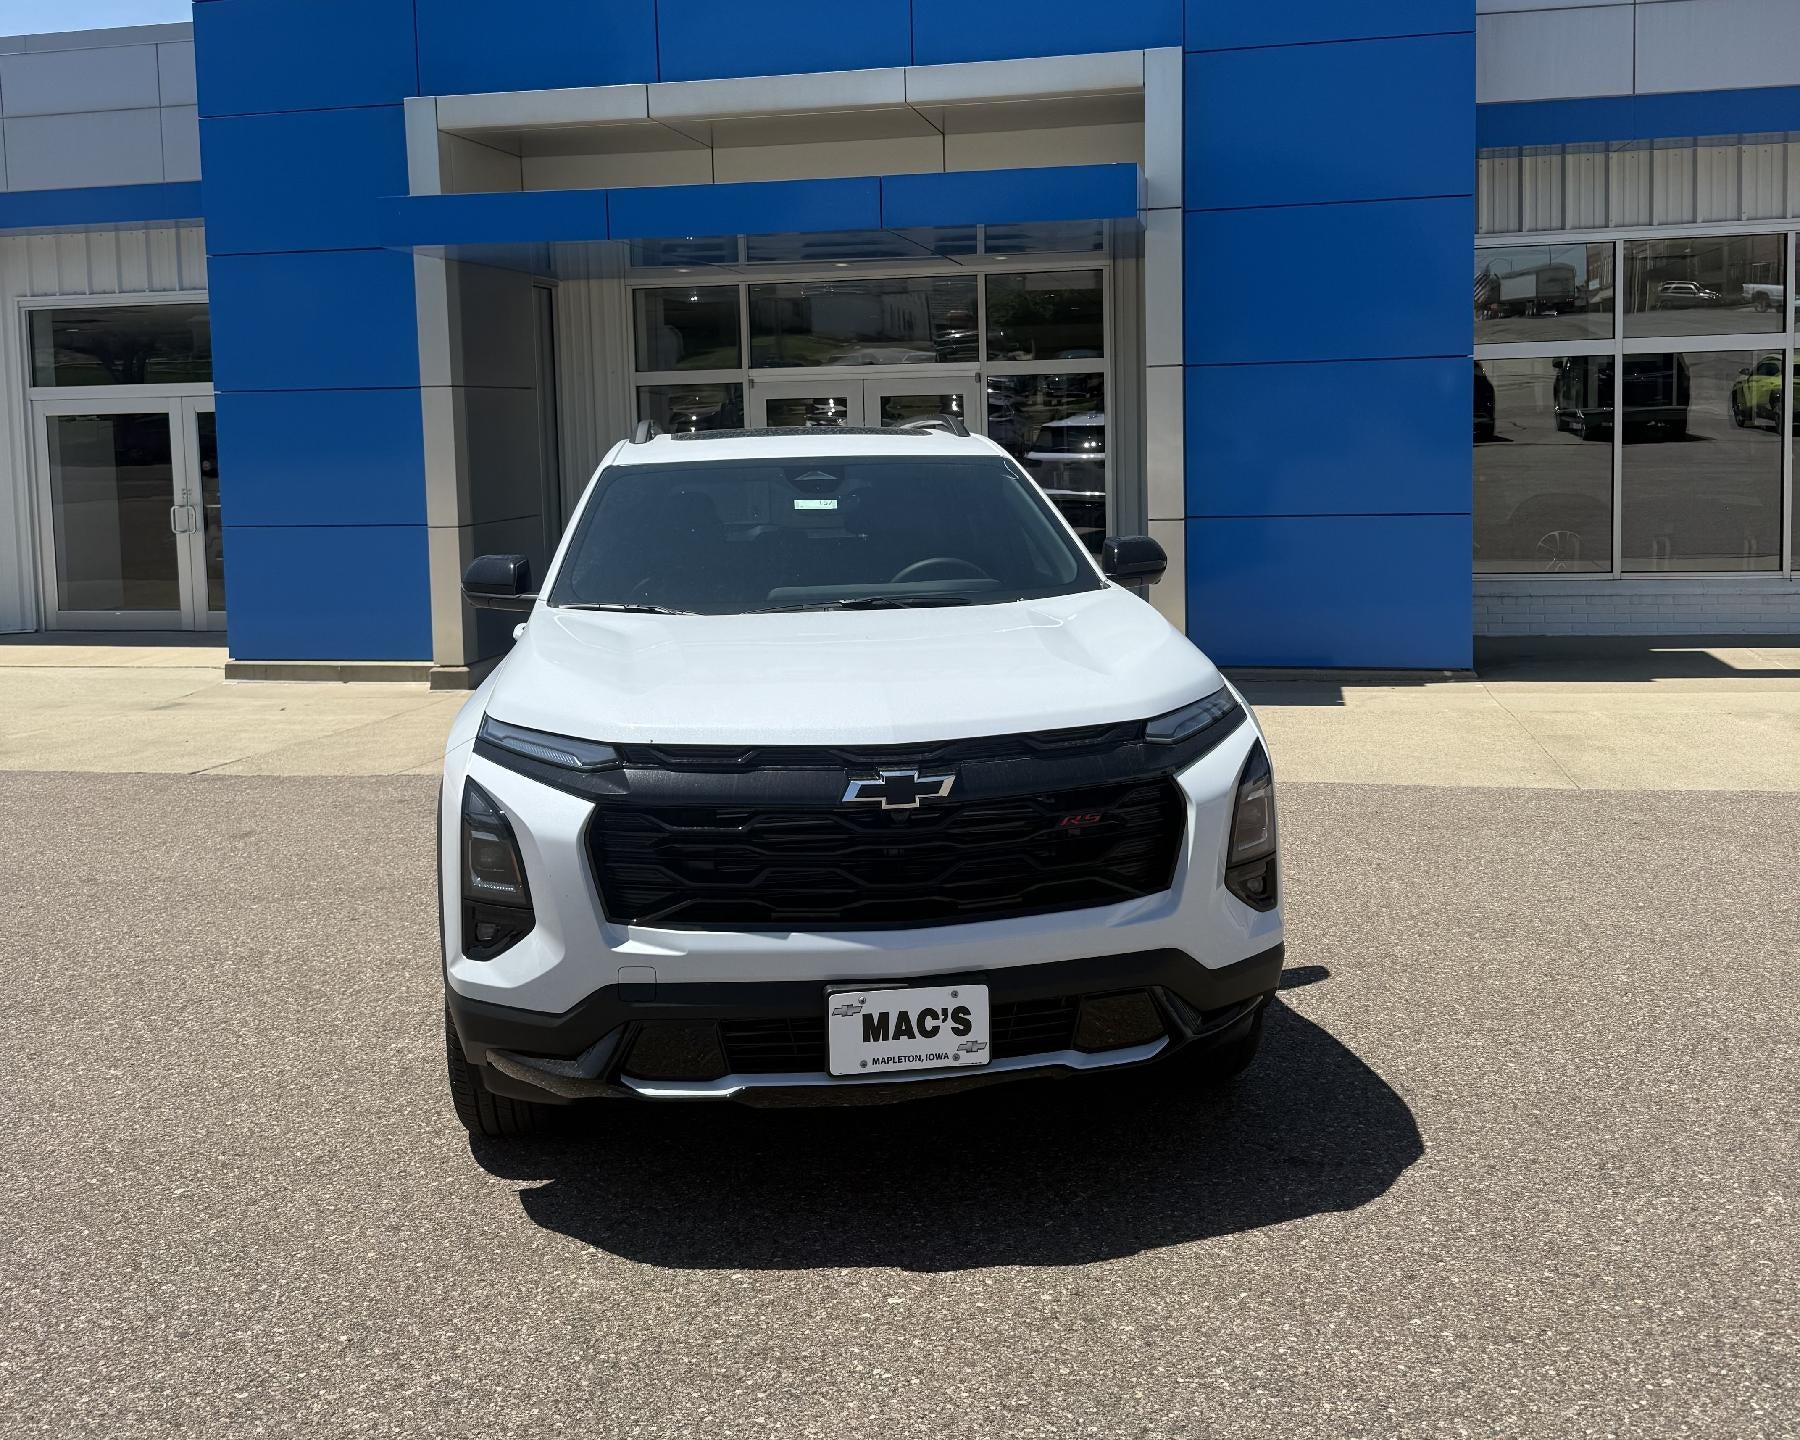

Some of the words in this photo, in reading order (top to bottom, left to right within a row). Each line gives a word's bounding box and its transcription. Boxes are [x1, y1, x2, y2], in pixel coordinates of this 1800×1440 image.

[1059, 813, 1102, 827] RS
[862, 1005, 973, 1043] MAC'S
[871, 1054, 924, 1066] MAPLETON,
[925, 1052, 950, 1062] IOWA
